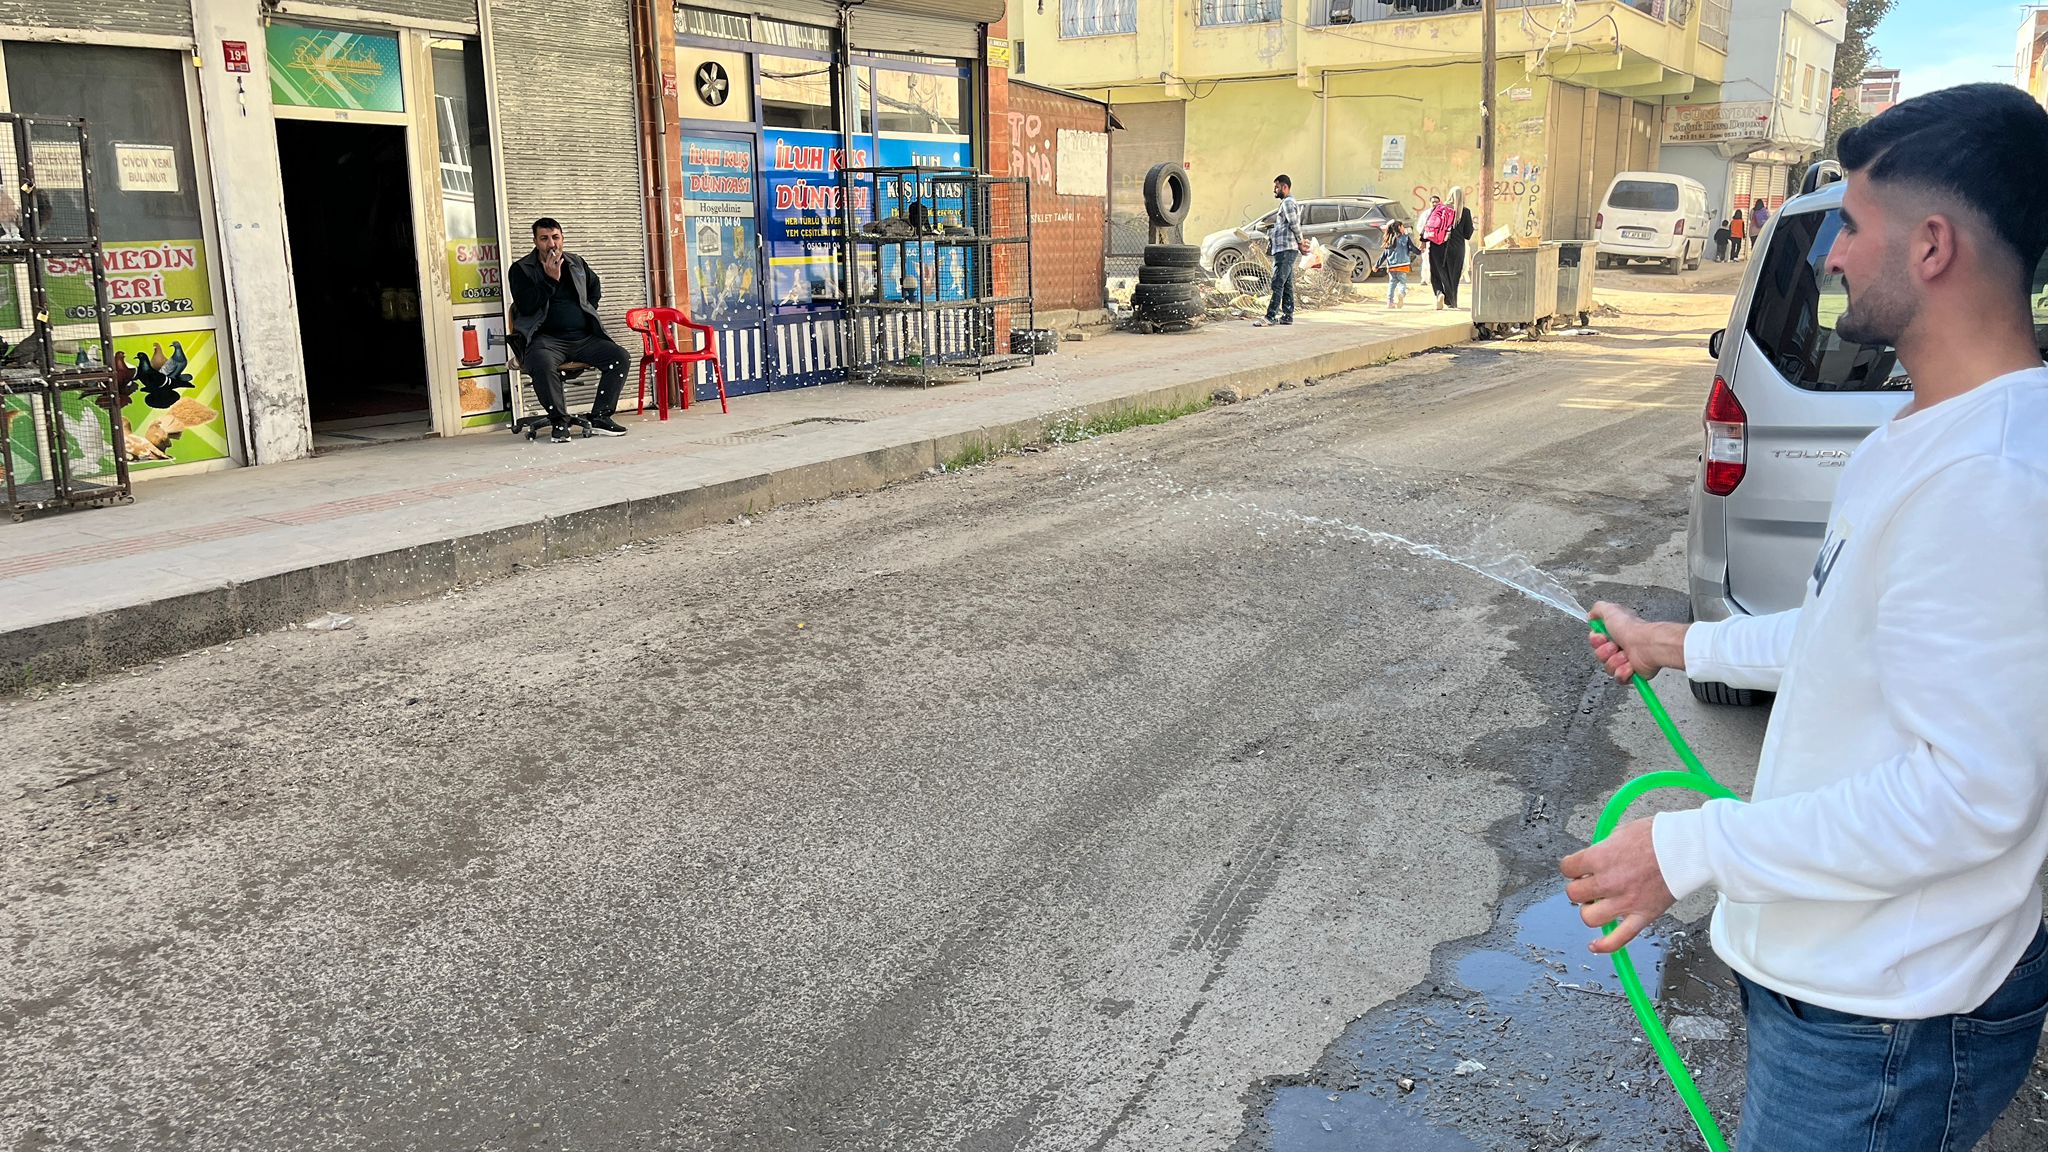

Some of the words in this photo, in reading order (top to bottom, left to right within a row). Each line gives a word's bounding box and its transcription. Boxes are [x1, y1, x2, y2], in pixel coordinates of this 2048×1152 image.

[689, 143, 721, 166] İLUH
[723, 151, 750, 173] KUŞ
[775, 138, 824, 171] İLUH
[128, 172, 168, 183] BULUNUR
[690, 172, 751, 194] DÜNYASI
[700, 202, 741, 214] Hoşgeldiniz
[468, 288, 491, 298] 0542
[75, 304, 117, 318] 052
[121, 302, 147, 316] 201
[151, 300, 171, 313] 56
[175, 299, 193, 311] 72
[1771, 449, 1851, 459] TOURN
